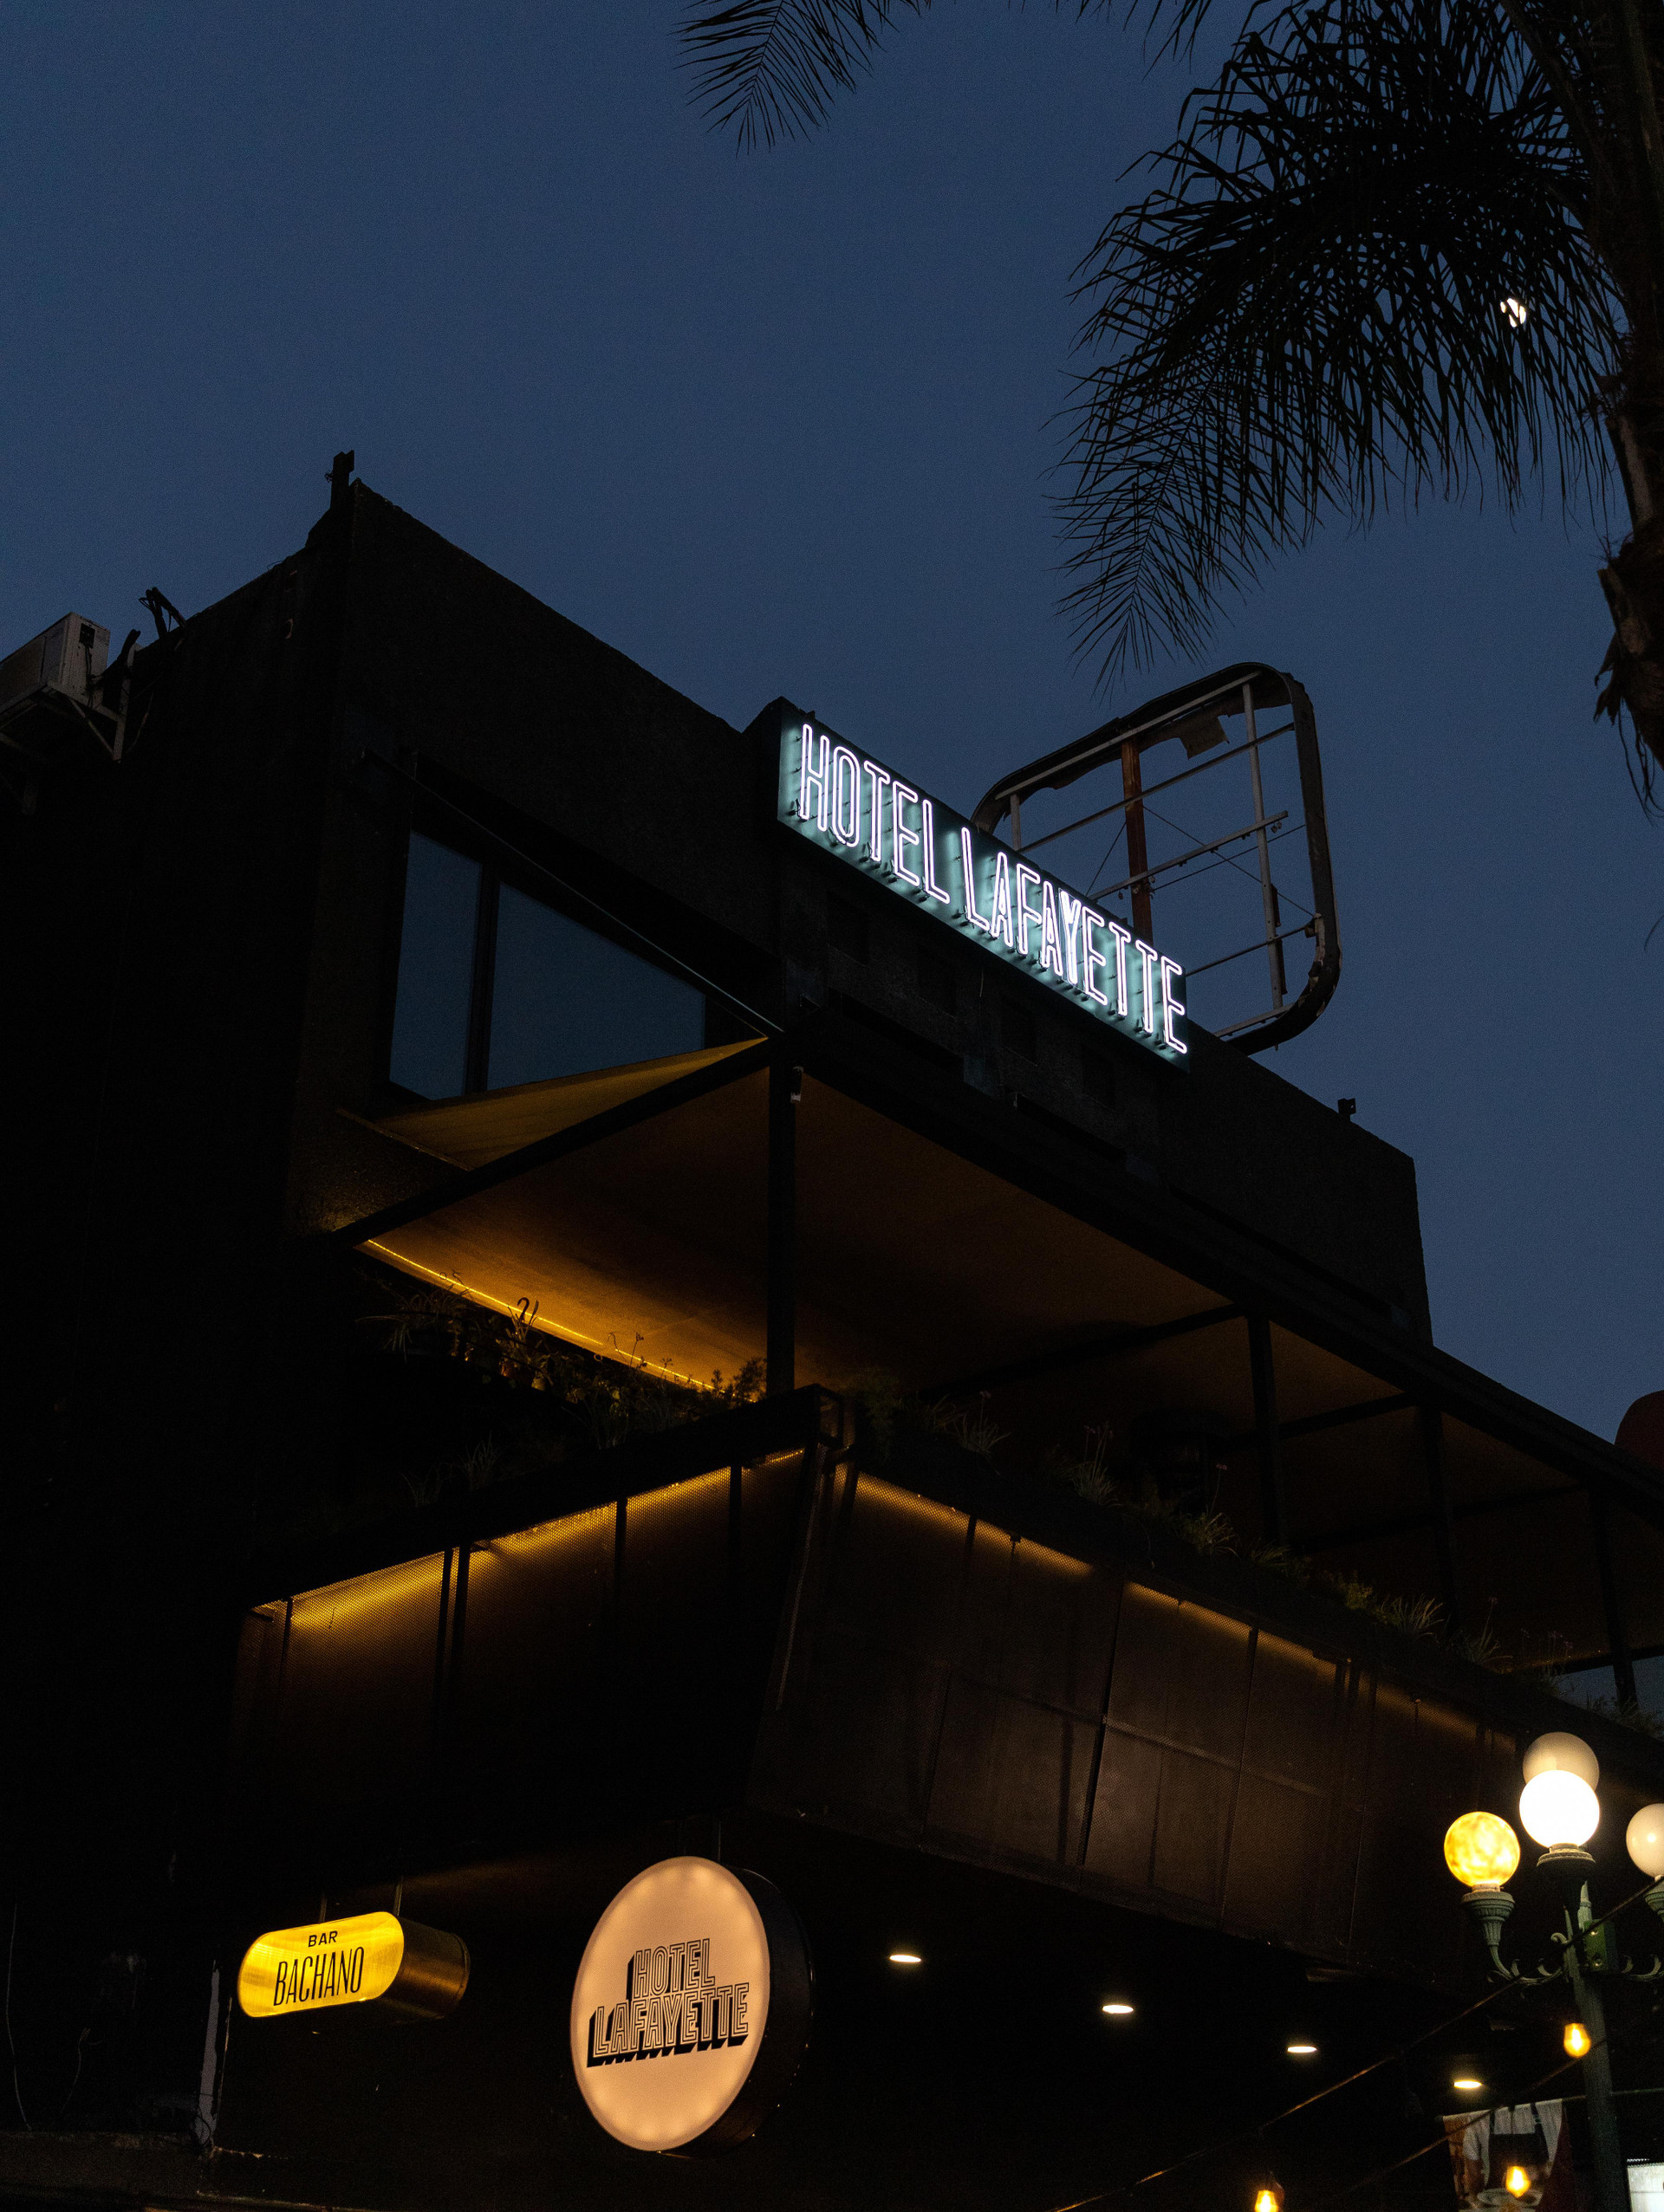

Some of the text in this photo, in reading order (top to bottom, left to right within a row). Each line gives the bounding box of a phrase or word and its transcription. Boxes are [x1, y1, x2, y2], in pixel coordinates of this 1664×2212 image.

[799, 723, 1188, 1054] HOTEL LAFAYETTE
[308, 1930, 338, 1948] BAR
[626, 1938, 716, 2000] HOTEL
[273, 1946, 365, 2007] BACHANO
[586, 1982, 751, 2068] LAFAYETTE
